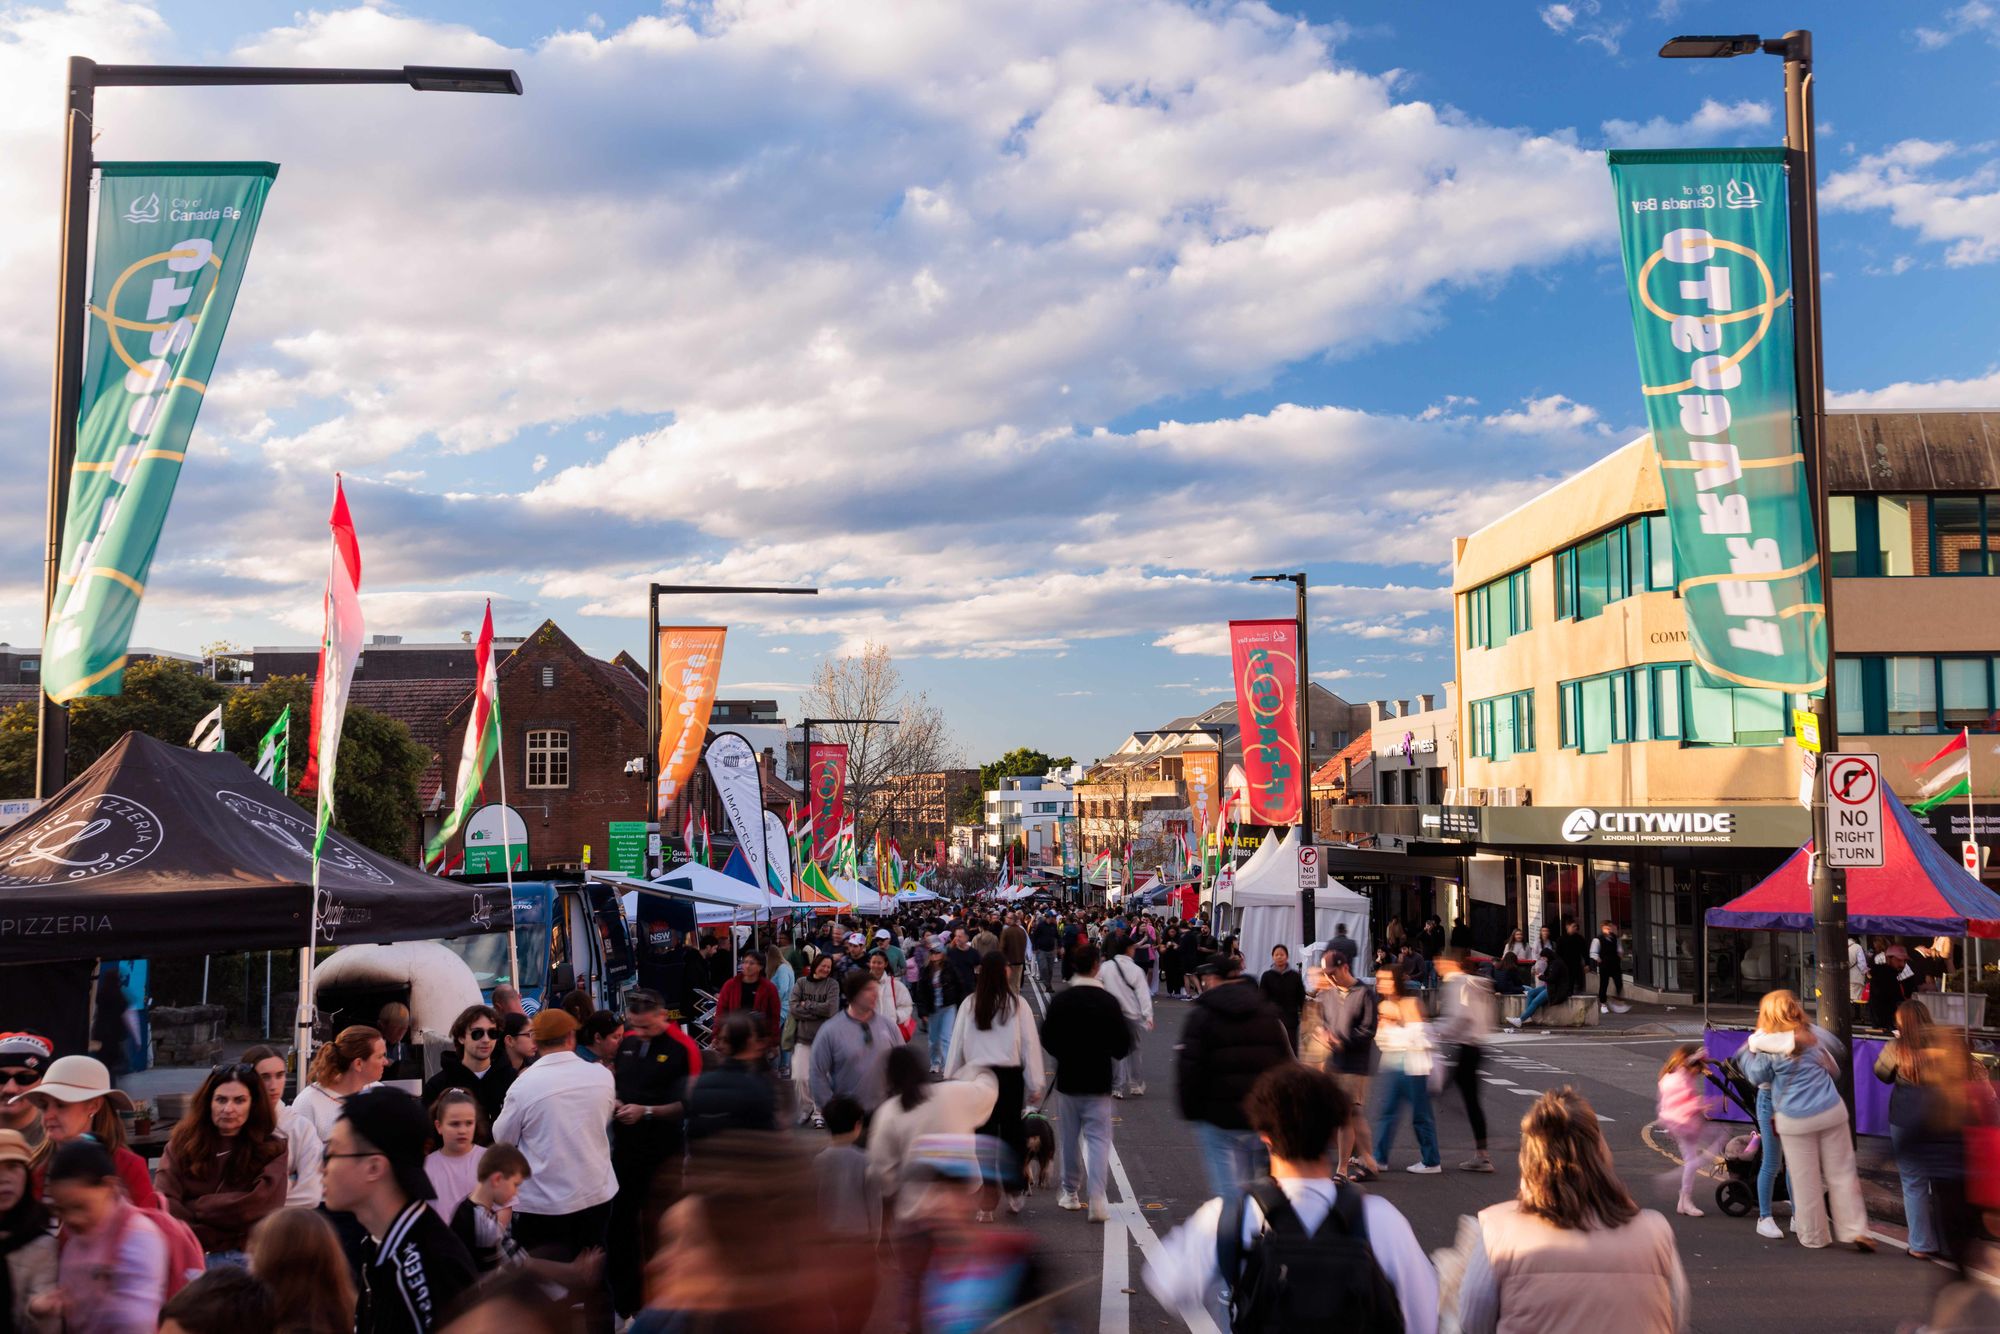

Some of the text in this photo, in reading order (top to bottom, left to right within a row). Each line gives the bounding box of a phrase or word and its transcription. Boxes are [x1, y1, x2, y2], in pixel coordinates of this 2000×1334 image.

[172, 198, 190, 209] City
[169, 206, 241, 222] Canada Ba
[1410, 740, 1434, 754] FITNESS
[82, 799, 152, 844] PIZZERIA
[723, 787, 758, 863] LIMONCELLO
[1600, 812, 1731, 832] CITYWIDE
[1840, 810, 1868, 826] NO
[1224, 835, 1265, 848] WAFFL
[1834, 831, 1875, 843] RIGHT
[1837, 847, 1875, 859] TURN
[68, 846, 144, 880] LUCIO
[0, 914, 113, 936] PIZZERIA
[650, 931, 671, 942] NSW
